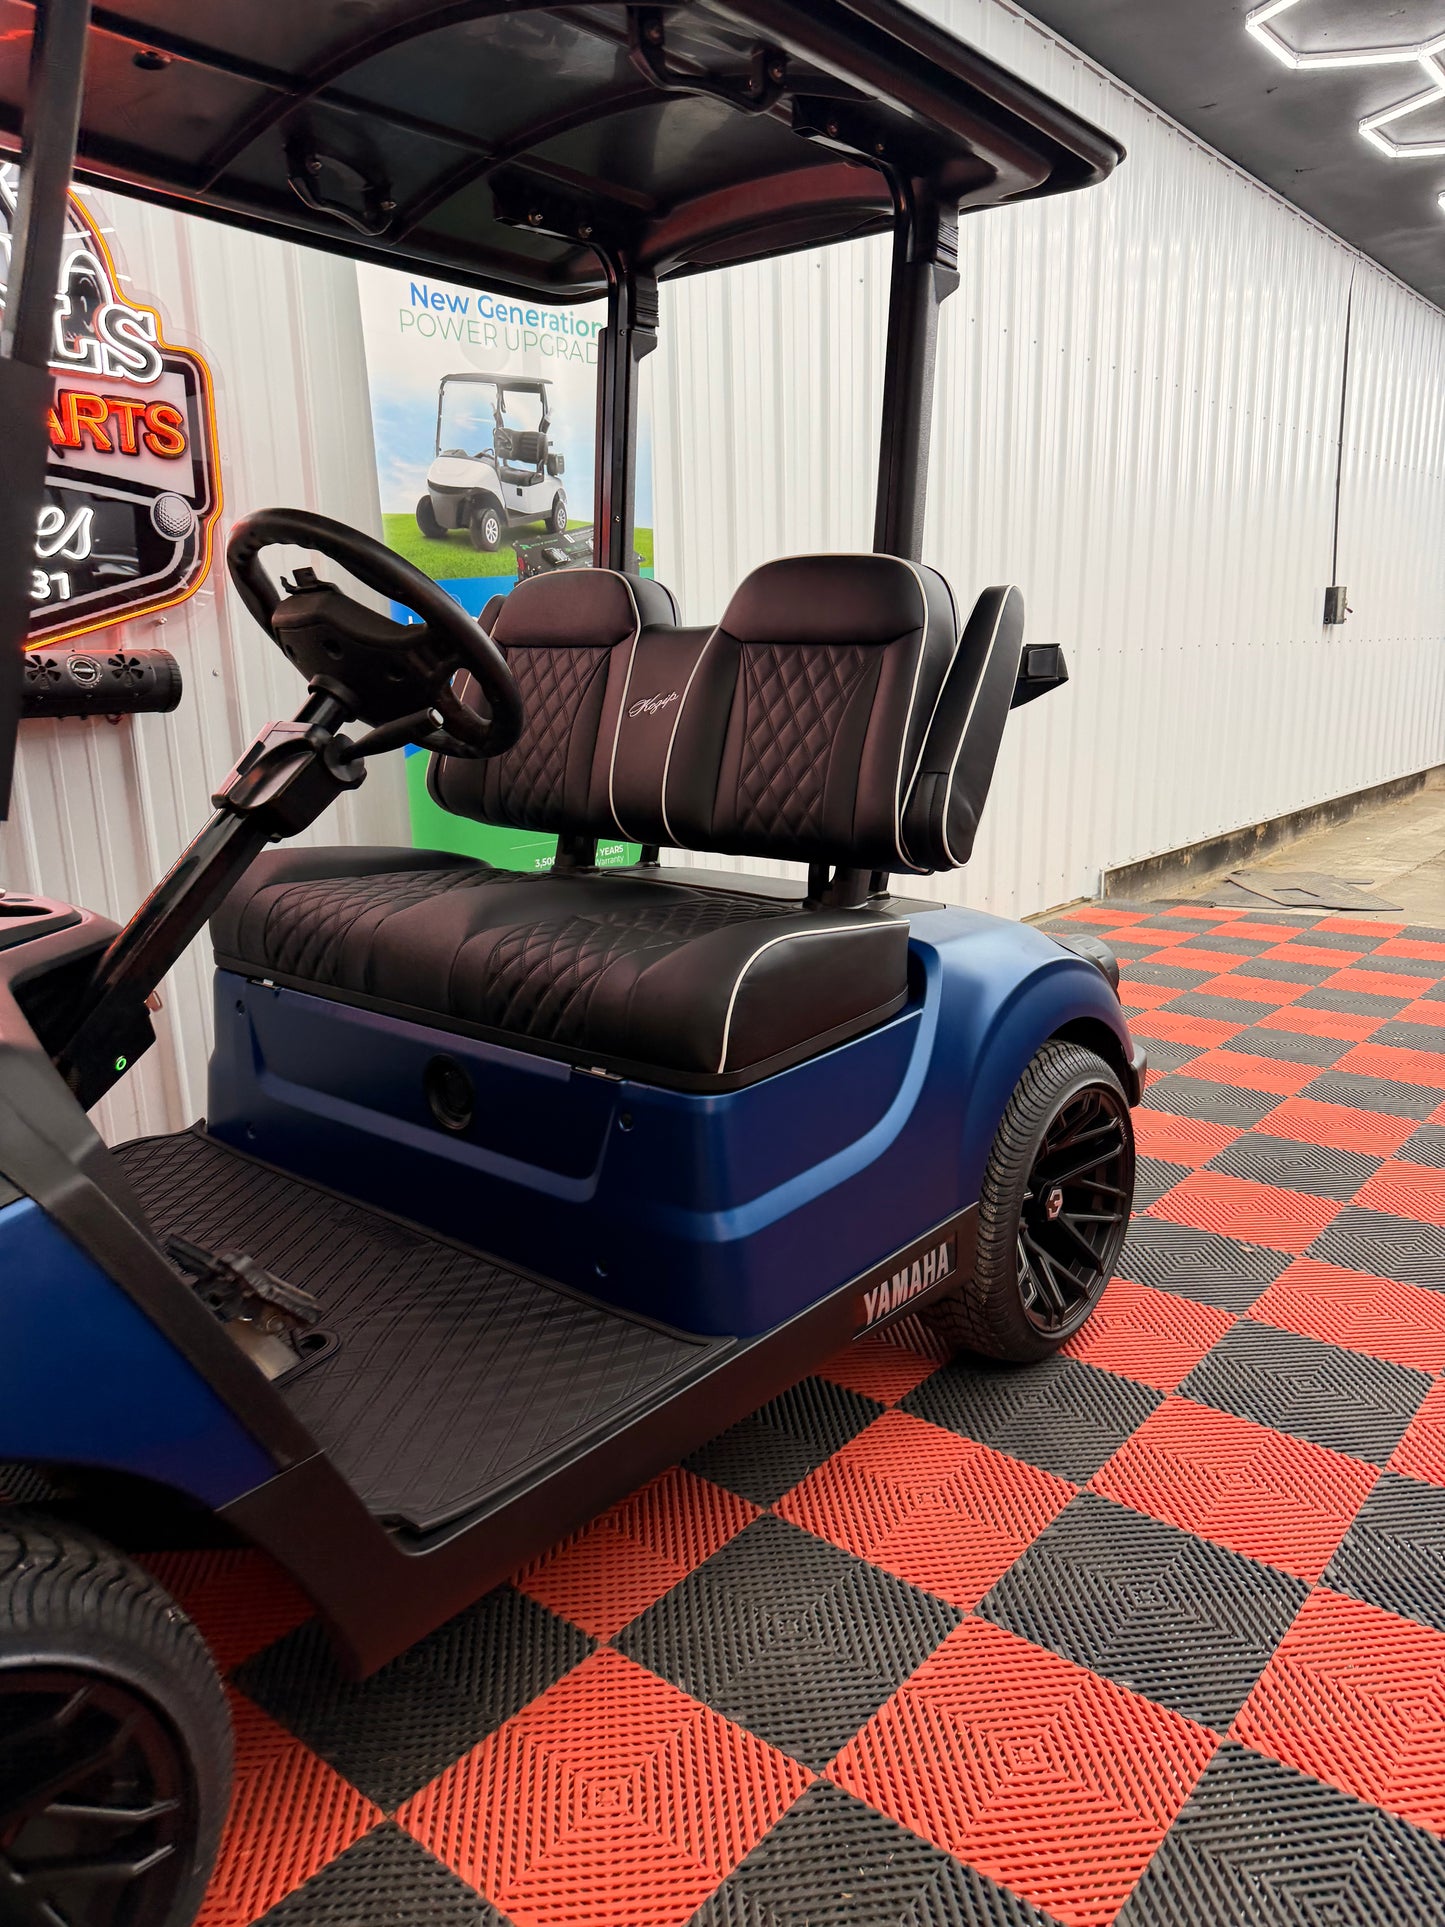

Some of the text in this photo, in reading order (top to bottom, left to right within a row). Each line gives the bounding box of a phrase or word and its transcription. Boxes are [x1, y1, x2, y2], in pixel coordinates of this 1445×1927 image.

[399, 308, 498, 348] POWER
[410, 282, 603, 339] New Generation
[600, 845, 624, 856] YEARS
[863, 1242, 949, 1326] YAMAHA
